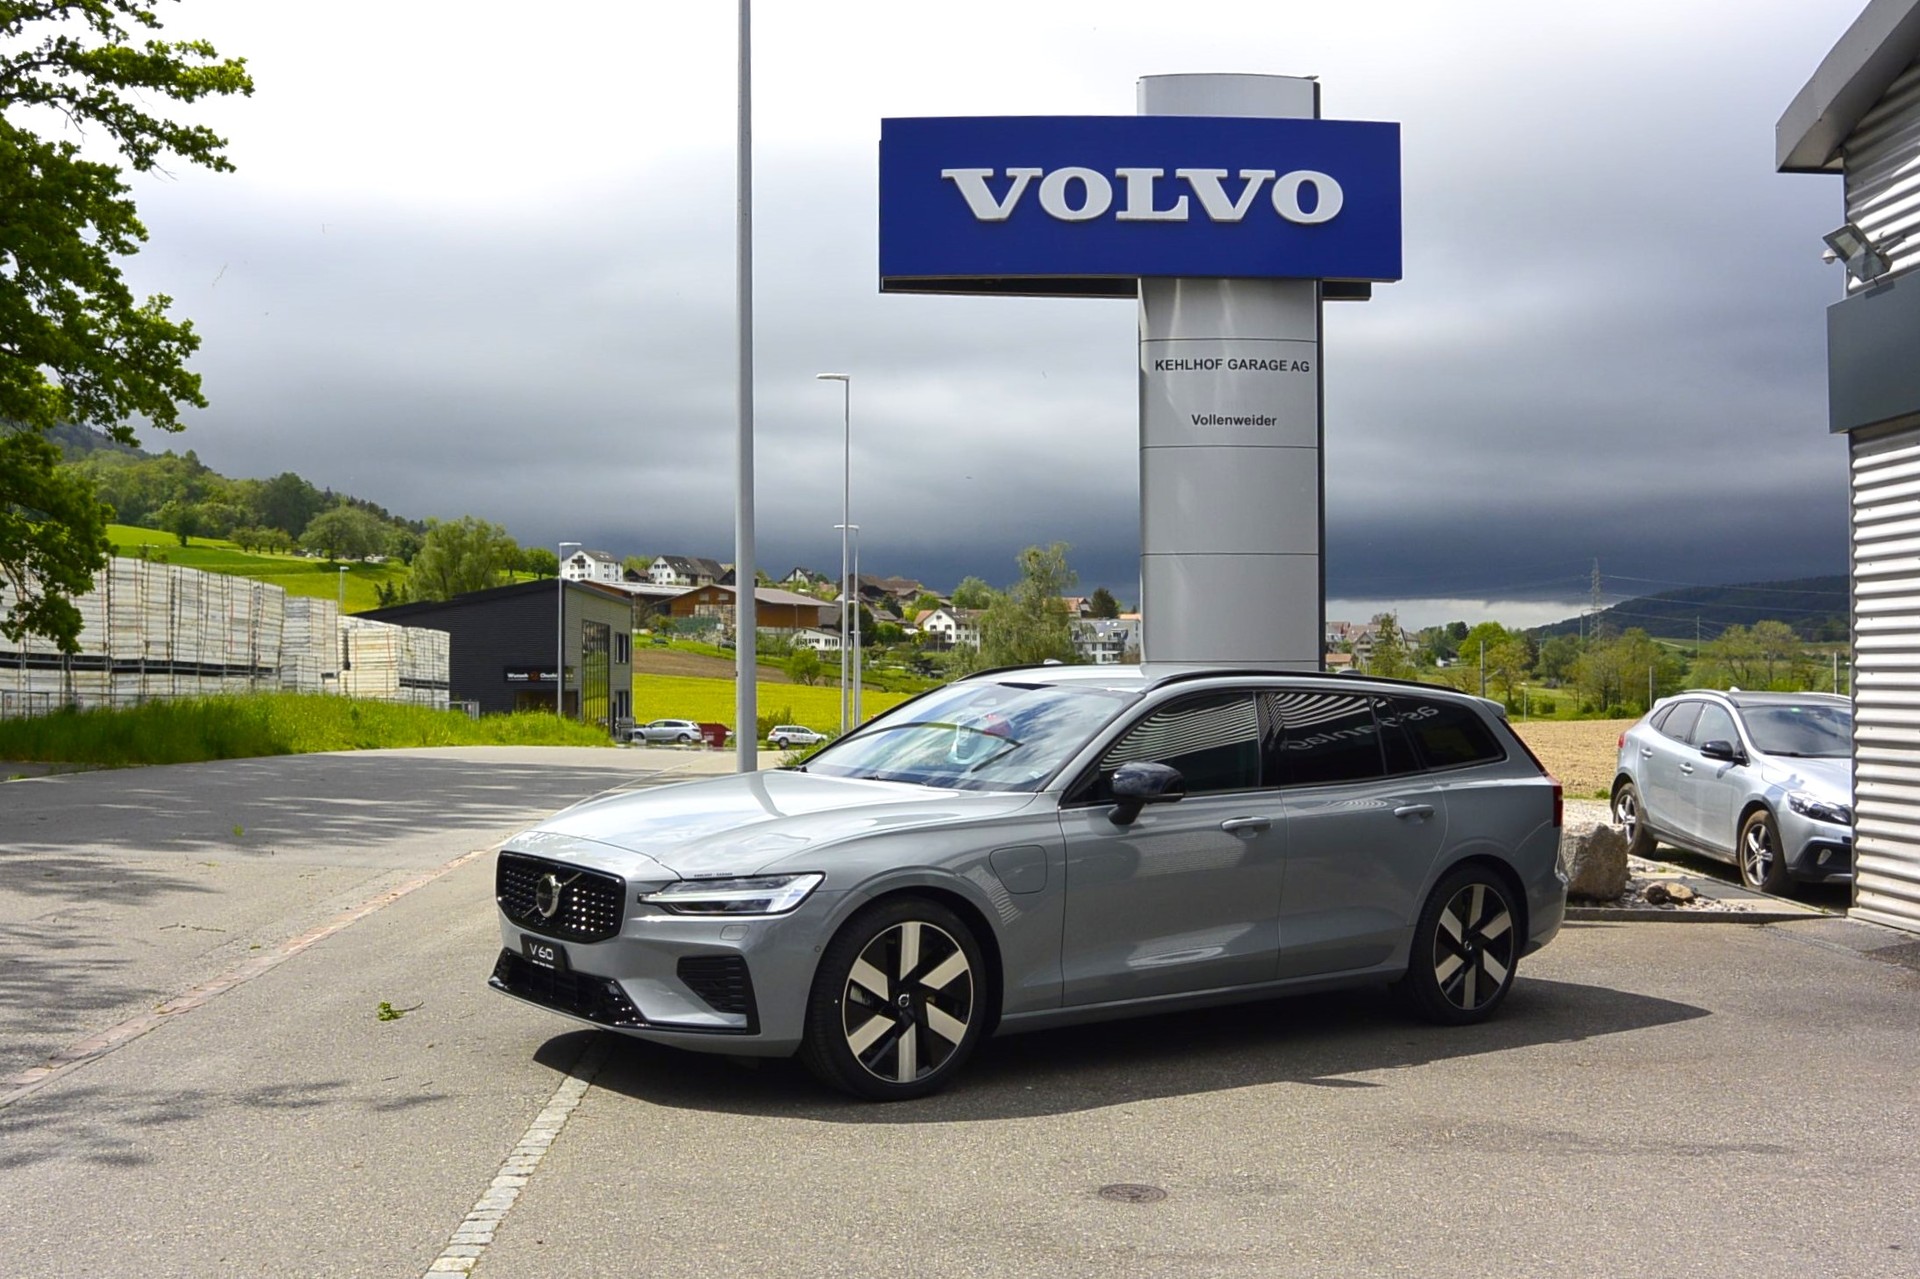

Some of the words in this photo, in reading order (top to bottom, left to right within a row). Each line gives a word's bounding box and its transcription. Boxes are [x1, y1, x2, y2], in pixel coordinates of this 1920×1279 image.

[941, 166, 1344, 225] VOLVO
[1155, 358, 1223, 371] KEHLHOF
[1228, 358, 1288, 372] GARAGE
[1290, 360, 1310, 373] AG
[1191, 414, 1277, 427] Vollenweider
[529, 943, 554, 960] V60
